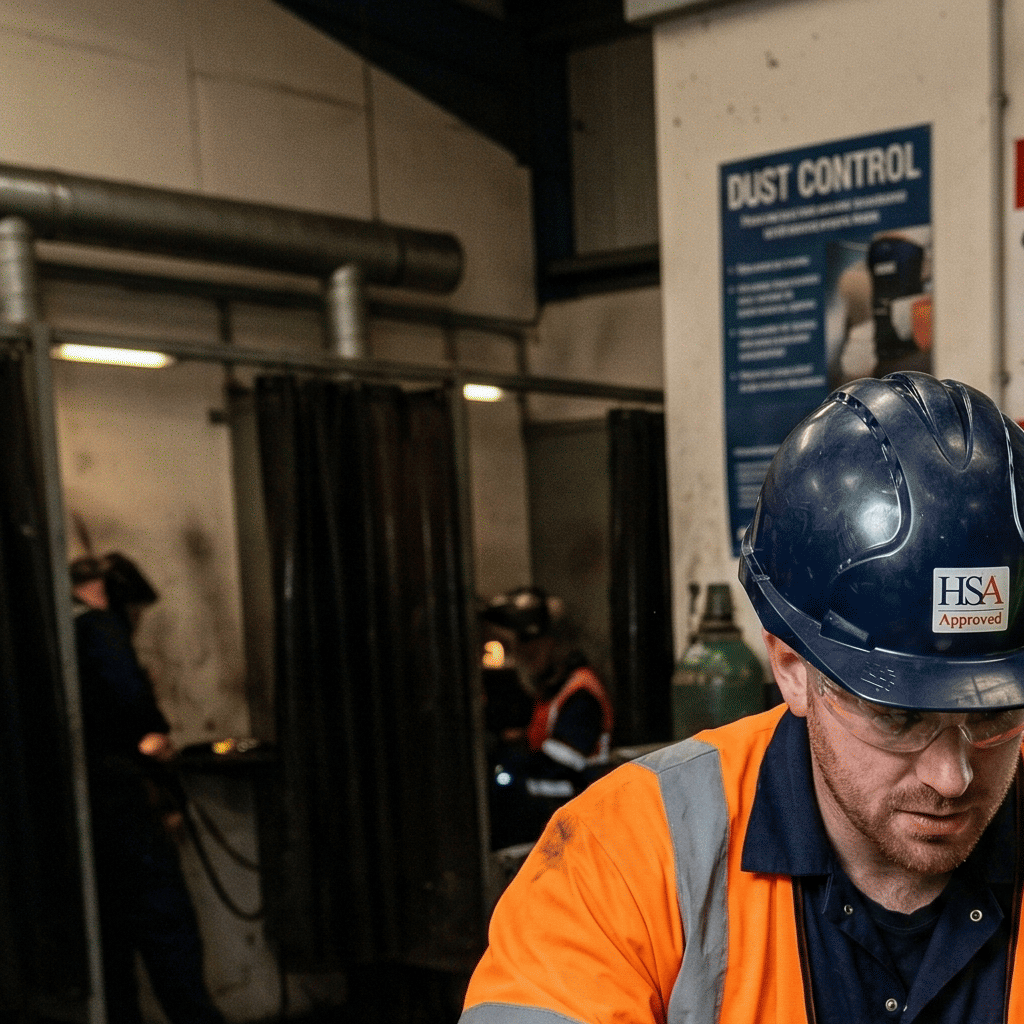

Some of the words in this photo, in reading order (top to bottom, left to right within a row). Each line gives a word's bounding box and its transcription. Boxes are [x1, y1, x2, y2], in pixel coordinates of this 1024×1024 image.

[727, 164, 792, 211] DUST
[797, 141, 922, 198] CONTROL
[938, 575, 1004, 606] HSA
[938, 612, 1002, 629] Approved
